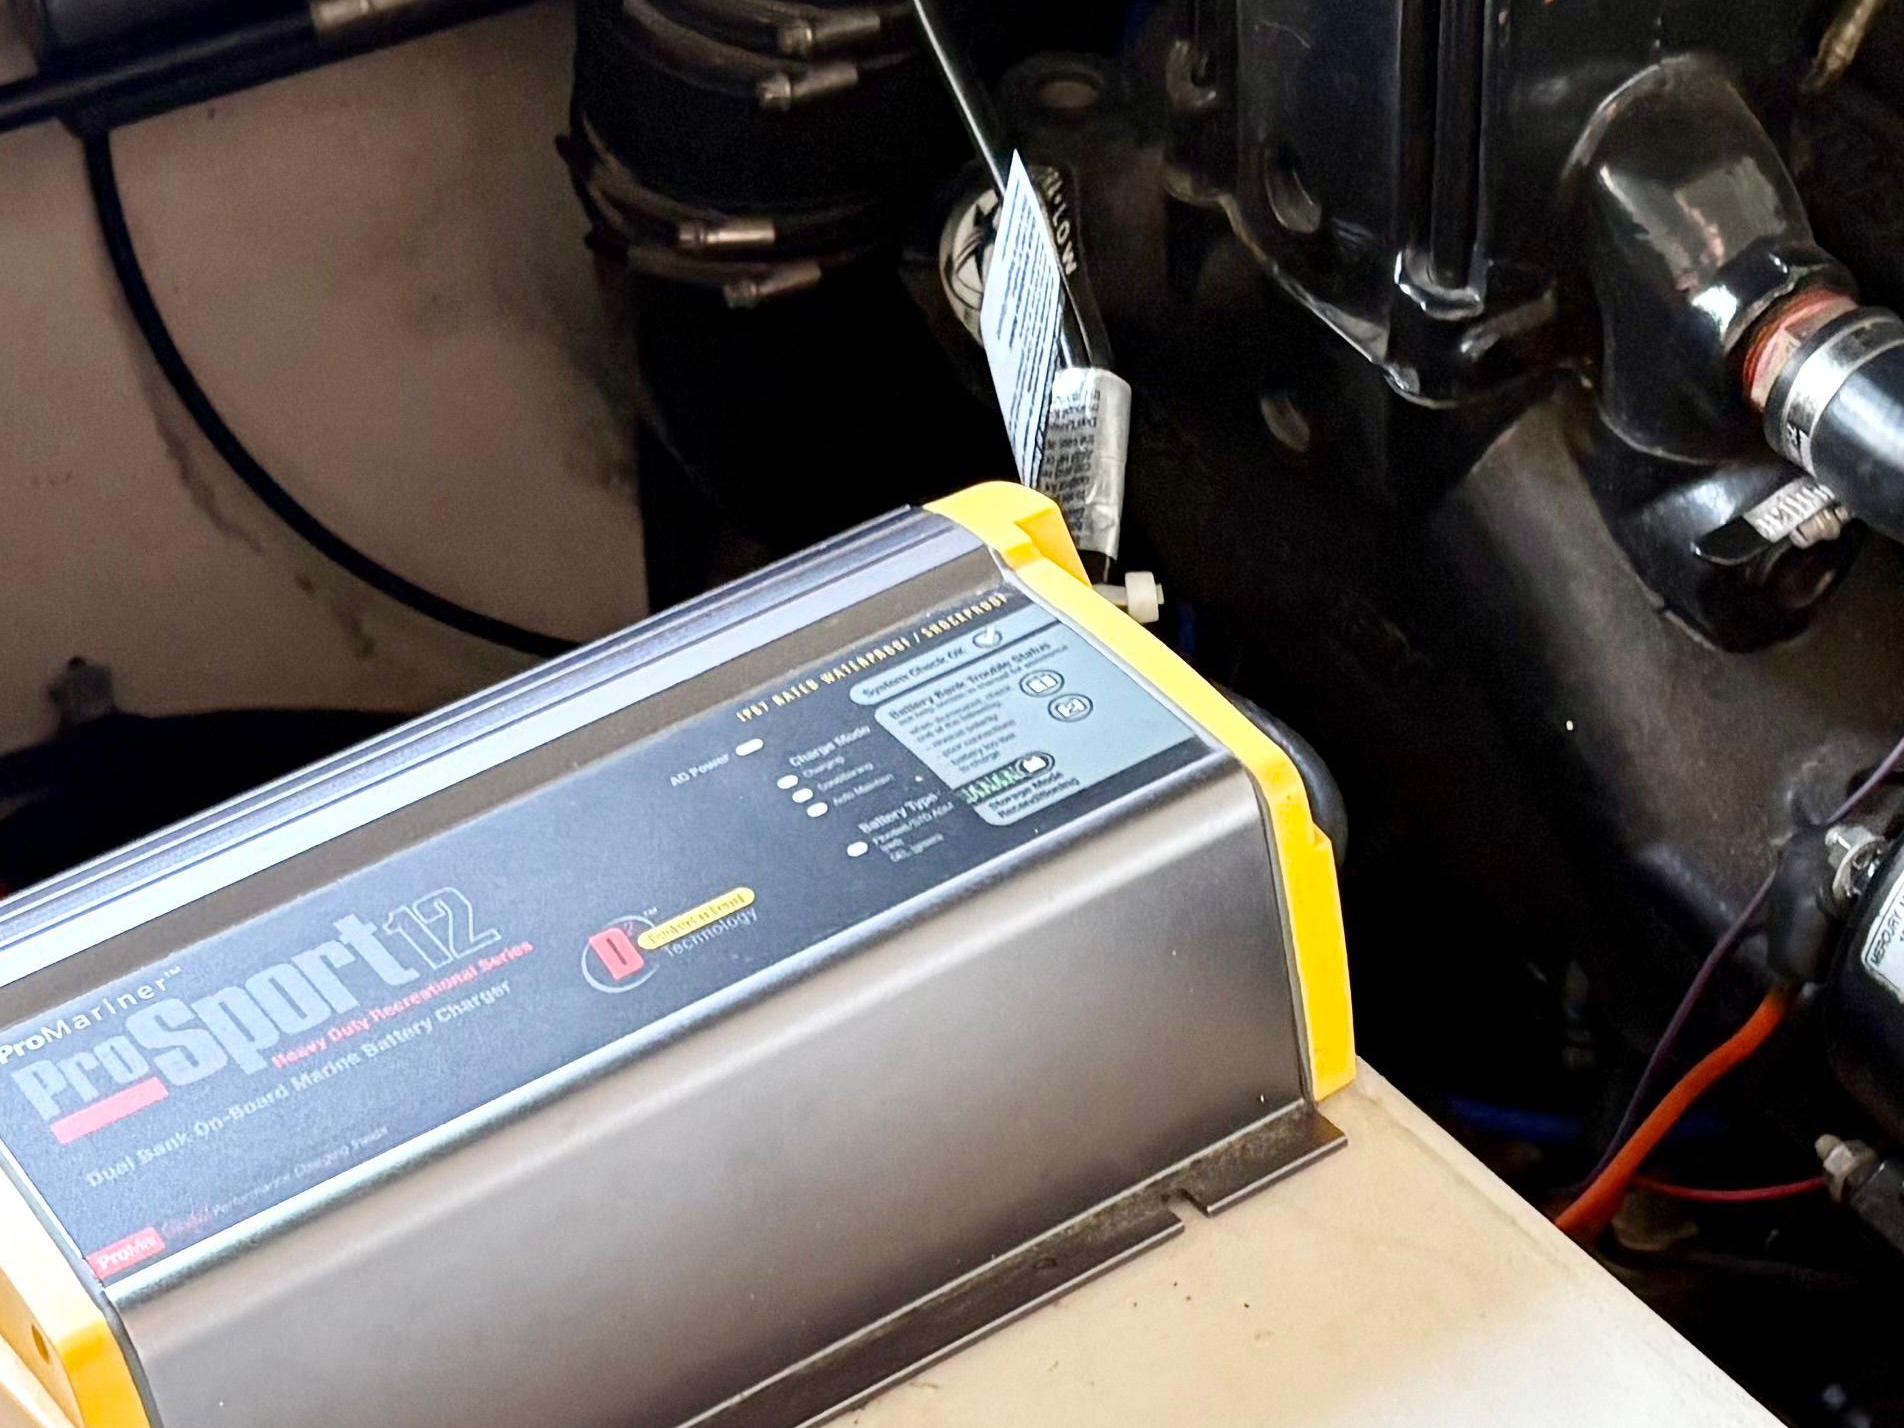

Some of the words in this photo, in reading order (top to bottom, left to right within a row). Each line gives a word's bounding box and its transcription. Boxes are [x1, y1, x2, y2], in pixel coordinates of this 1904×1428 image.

[772, 678, 819, 706] RATED
[819, 636, 911, 684] WATERPROOF
[919, 591, 1008, 638] SHOCKPROOF
[889, 694, 934, 720] Battery
[934, 680, 966, 699] Bank
[967, 659, 1011, 684] Trouble
[1012, 641, 1050, 663] Status
[689, 753, 731, 777] Power
[789, 740, 836, 768] Charge
[859, 805, 908, 835] Battery
[663, 906, 761, 959] Technology
[268, 1034, 329, 1070] Heavy
[325, 1014, 372, 1043] Duty
[368, 964, 480, 1022] Recreational
[476, 938, 535, 972] Series
[84, 1154, 138, 1188] Dual
[134, 1128, 193, 1164] Bank
[190, 1083, 290, 1138] On-Board
[288, 1049, 362, 1091] Marine
[359, 1015, 436, 1059] Battery
[432, 978, 516, 1025] Charger
